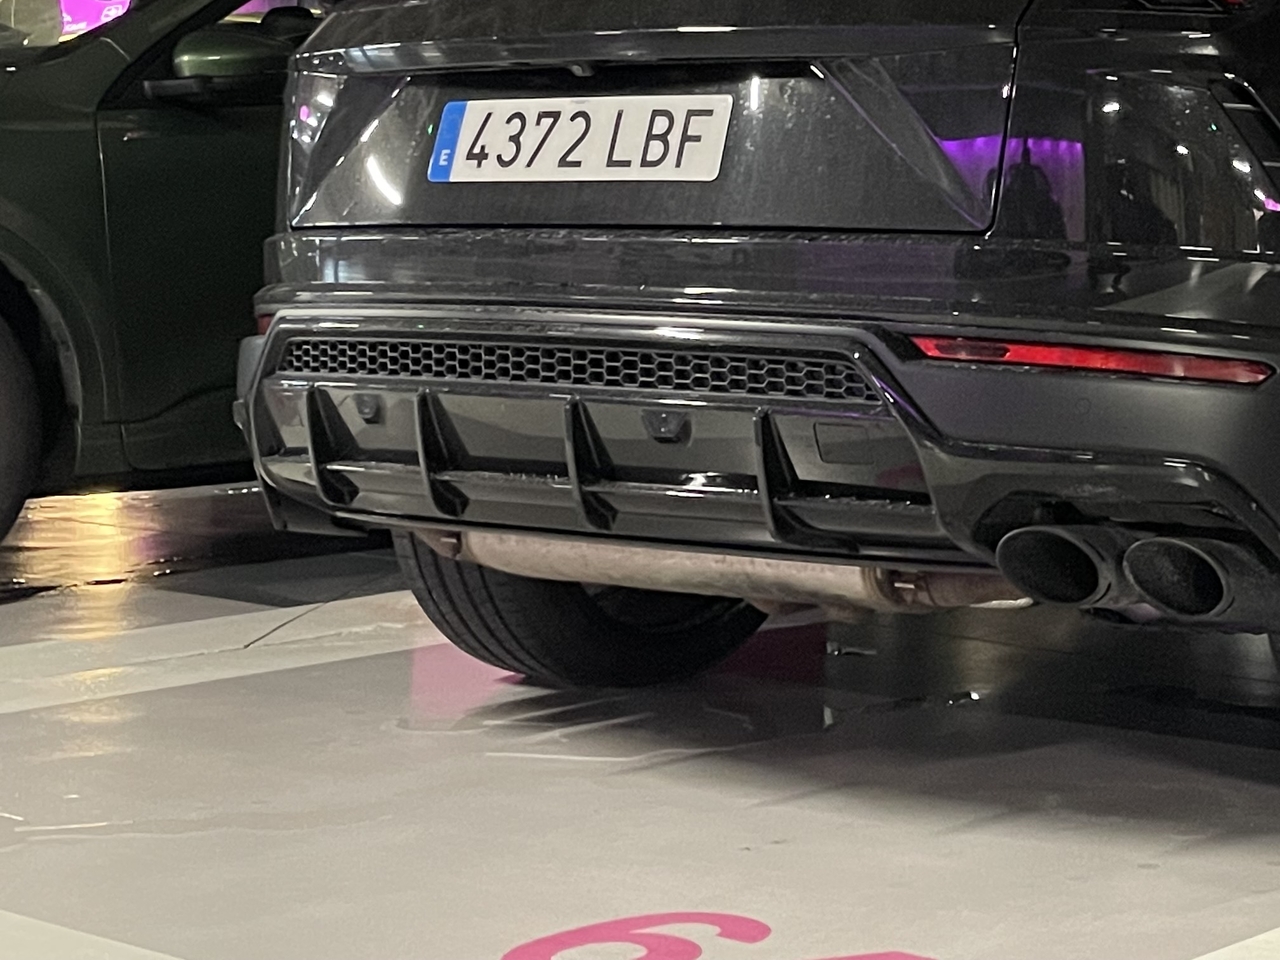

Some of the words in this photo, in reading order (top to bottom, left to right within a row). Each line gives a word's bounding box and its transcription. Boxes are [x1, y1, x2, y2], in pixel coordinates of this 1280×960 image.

[438, 148, 451, 166] E
[465, 109, 592, 169] 4372
[605, 108, 714, 169] LBF
